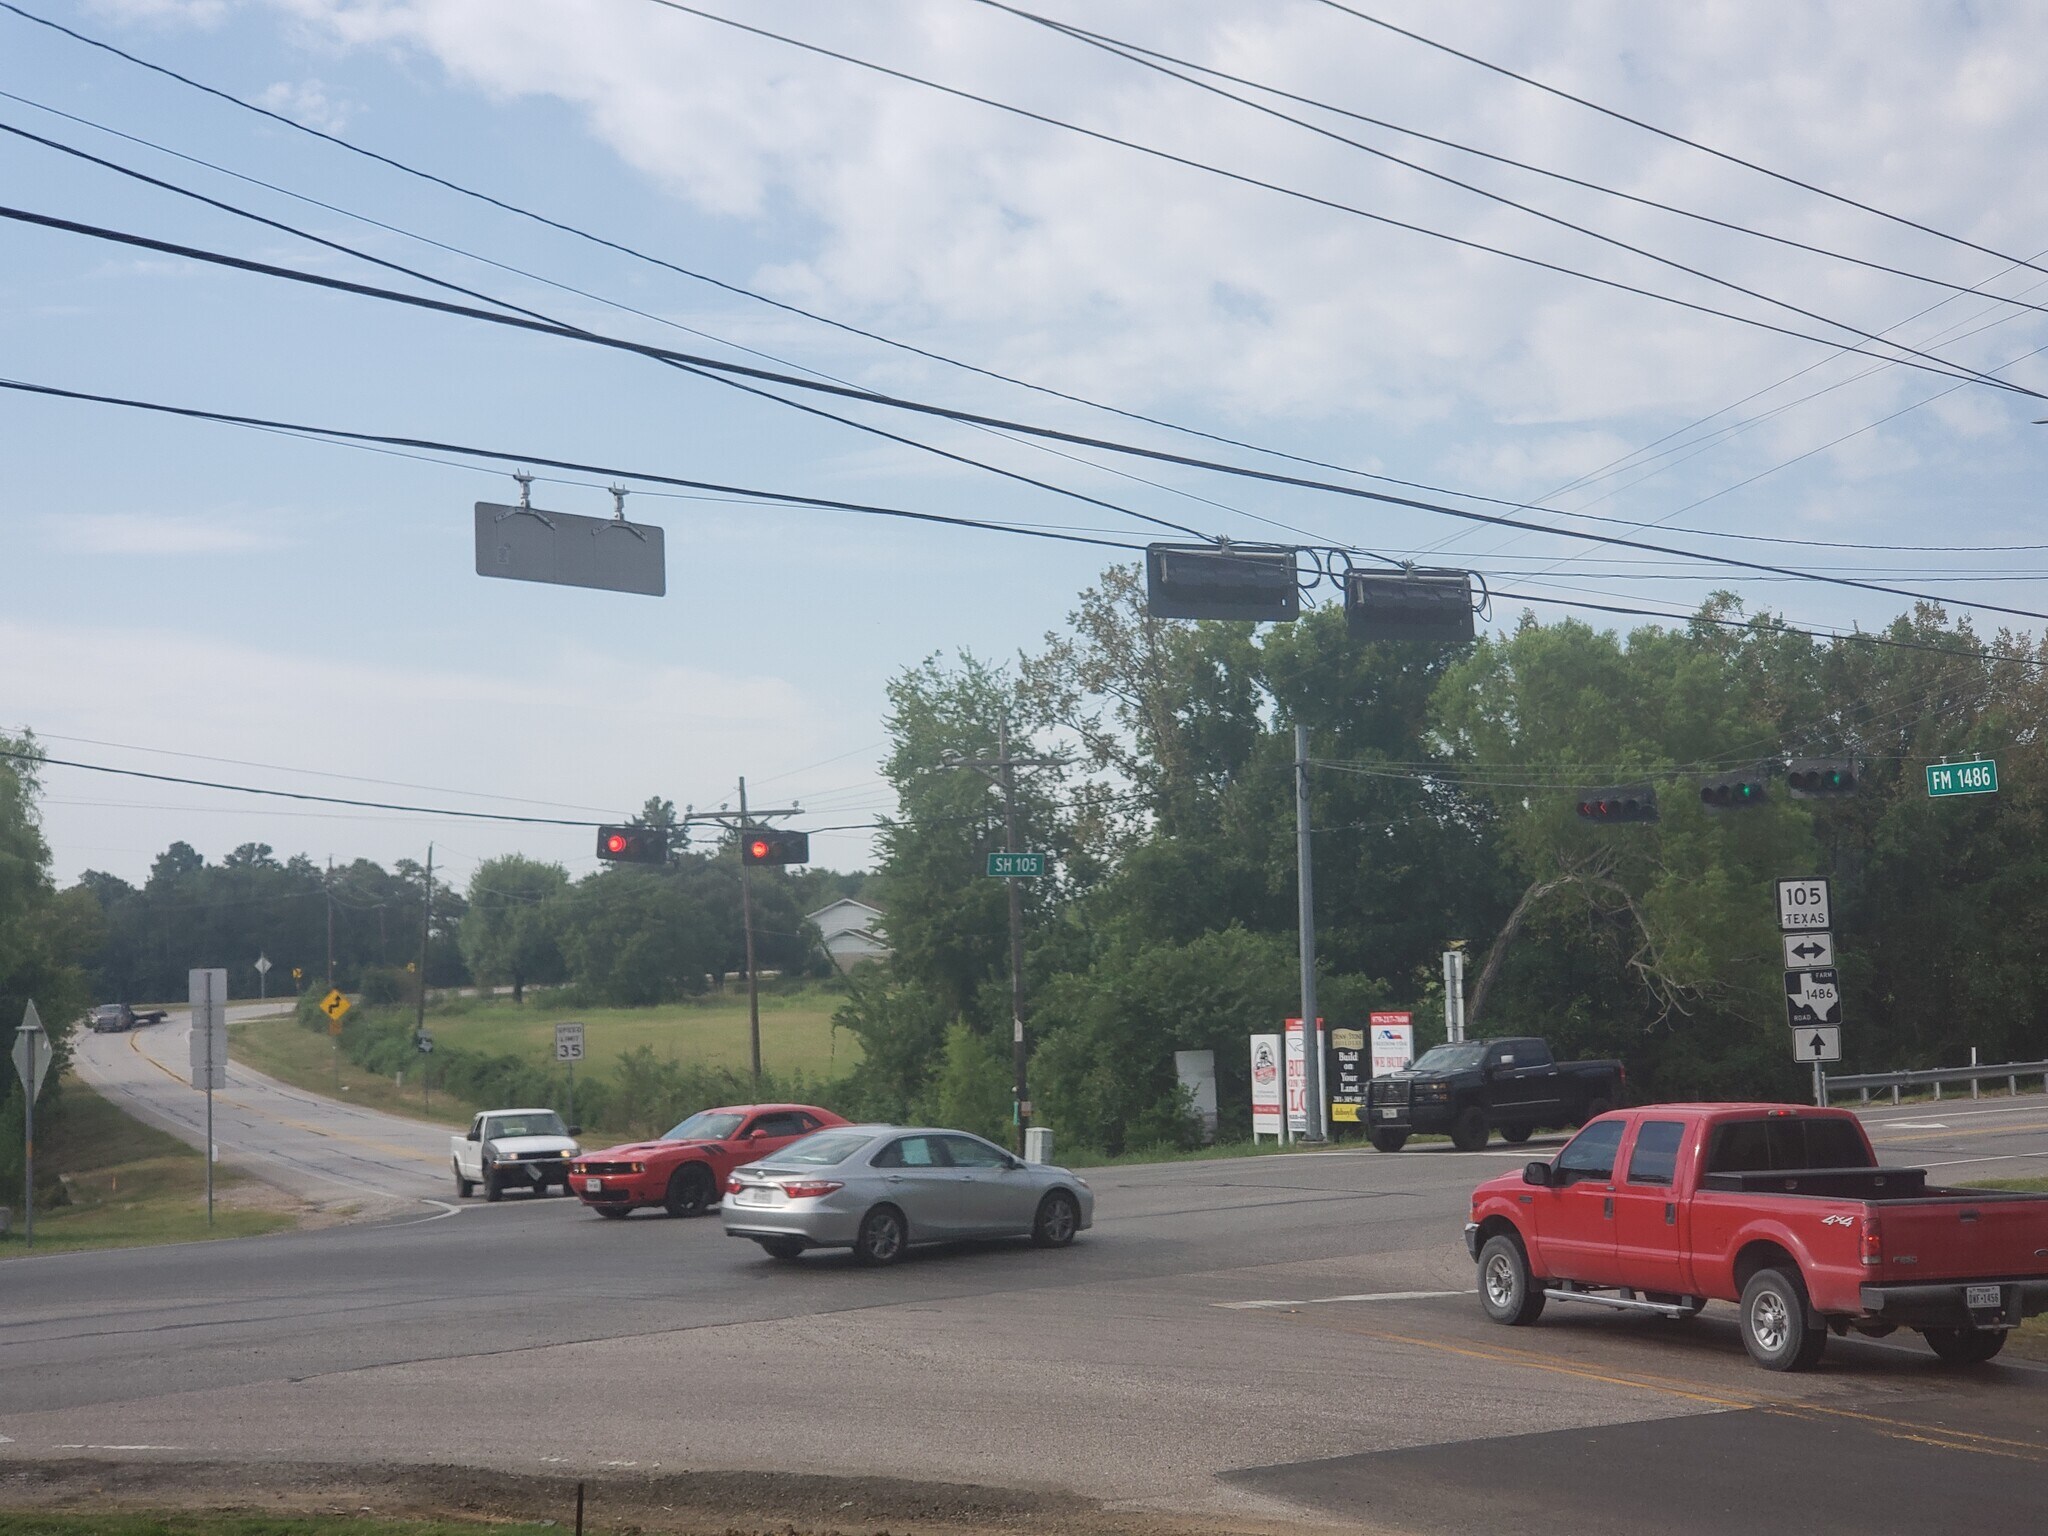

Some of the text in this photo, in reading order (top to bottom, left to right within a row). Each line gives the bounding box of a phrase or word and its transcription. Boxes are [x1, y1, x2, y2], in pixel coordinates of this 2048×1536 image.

[1933, 766, 1991, 790] FM 1486
[995, 858, 1037, 872] SH 105
[1786, 888, 1821, 906] 105
[1786, 913, 1825, 924] TEXAS
[1806, 988, 1833, 1000] 1486
[560, 1044, 581, 1057] 35
[1338, 1052, 1359, 1061] Build
[1374, 1056, 1385, 1067] WE
[1340, 1072, 1358, 1082] Your
[1340, 1083, 1359, 1092] Land
[1821, 1214, 1855, 1227] 4x4
